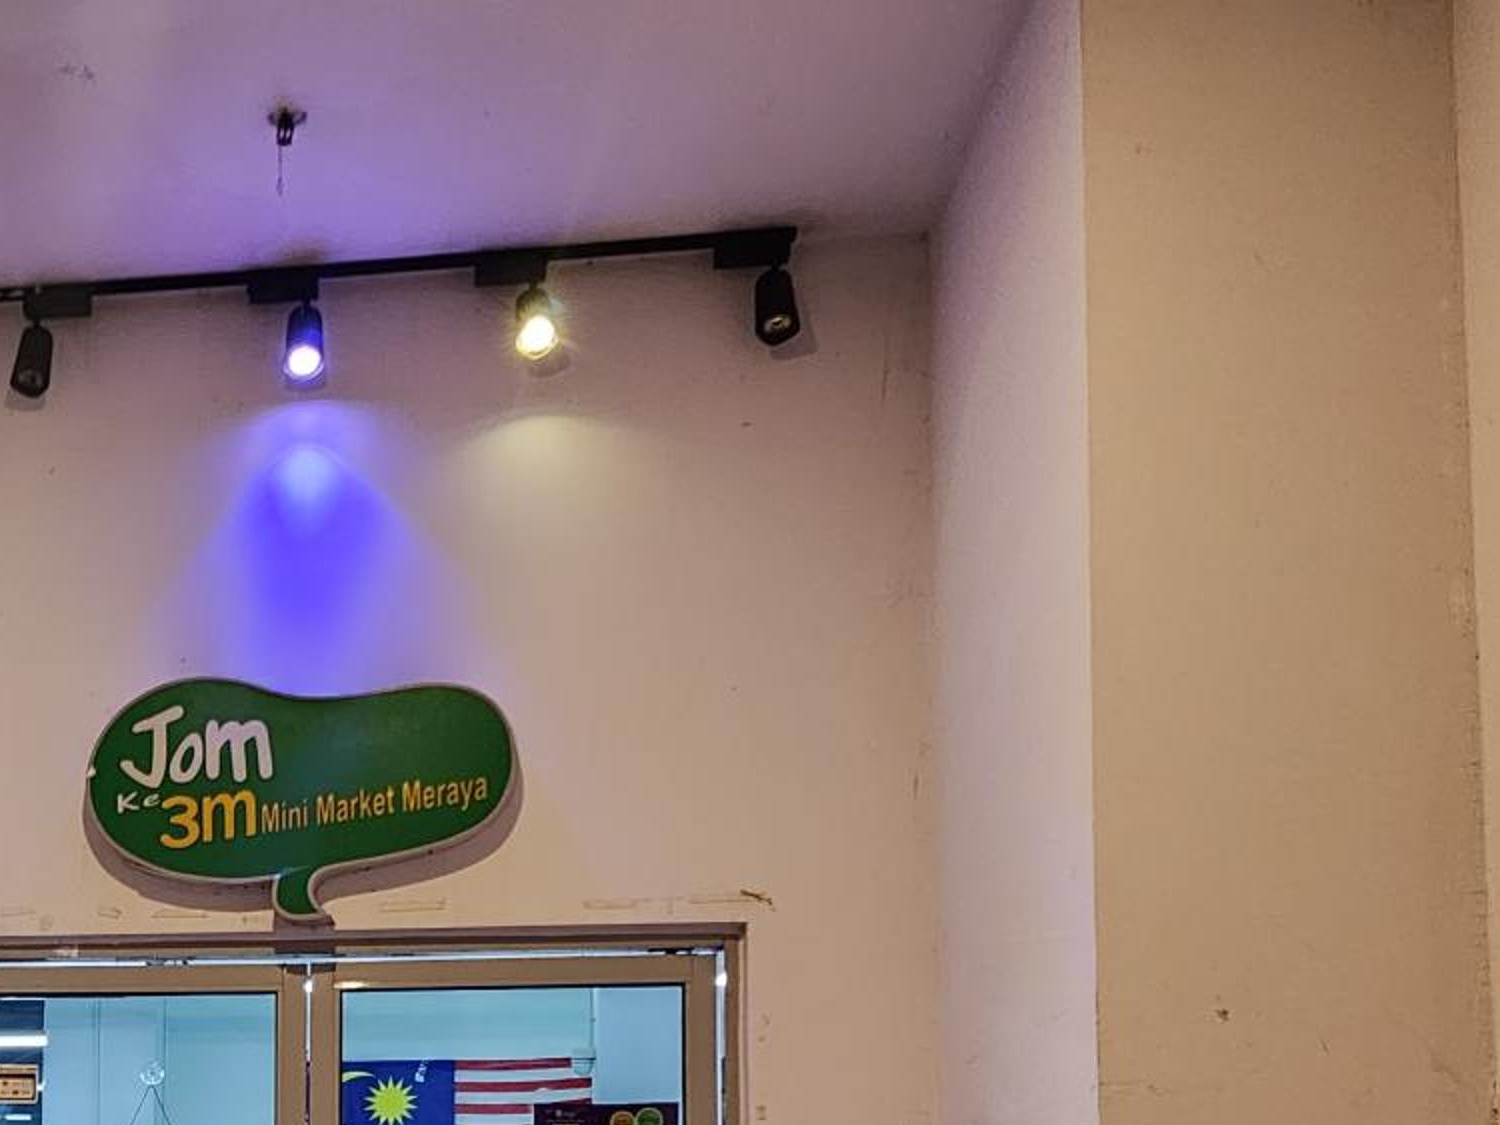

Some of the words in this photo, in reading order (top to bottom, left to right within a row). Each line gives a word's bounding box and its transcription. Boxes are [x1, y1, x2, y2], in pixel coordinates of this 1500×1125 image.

[120, 705, 273, 789] Jom
[117, 792, 160, 814] Ke
[160, 790, 256, 849] 3m
[261, 801, 308, 834] Mini
[317, 789, 395, 825] Market
[402, 777, 488, 812] Meraya
